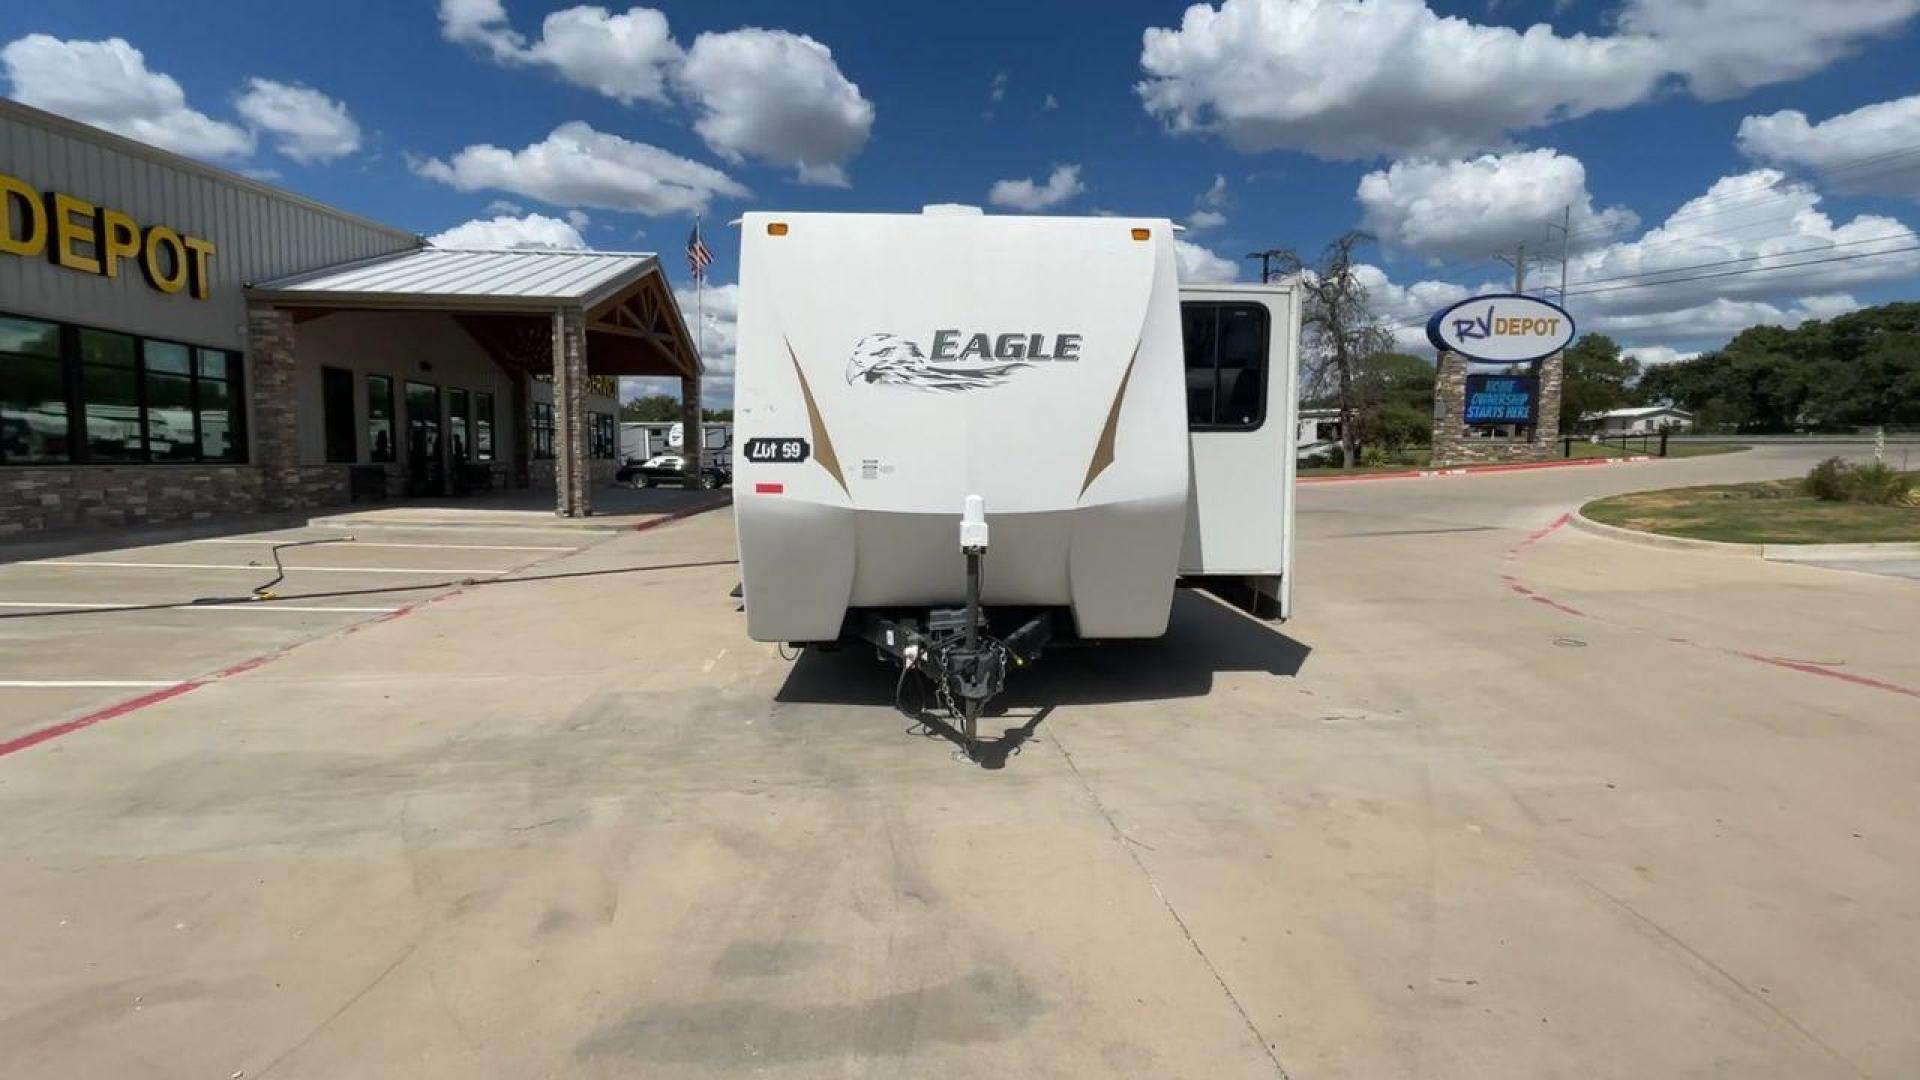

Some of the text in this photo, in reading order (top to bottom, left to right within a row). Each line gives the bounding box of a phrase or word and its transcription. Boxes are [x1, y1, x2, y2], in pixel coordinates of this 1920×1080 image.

[0, 174, 217, 299] DEPOT
[1452, 306, 1560, 344] RV DEPOT
[930, 329, 1084, 362] EAGLE
